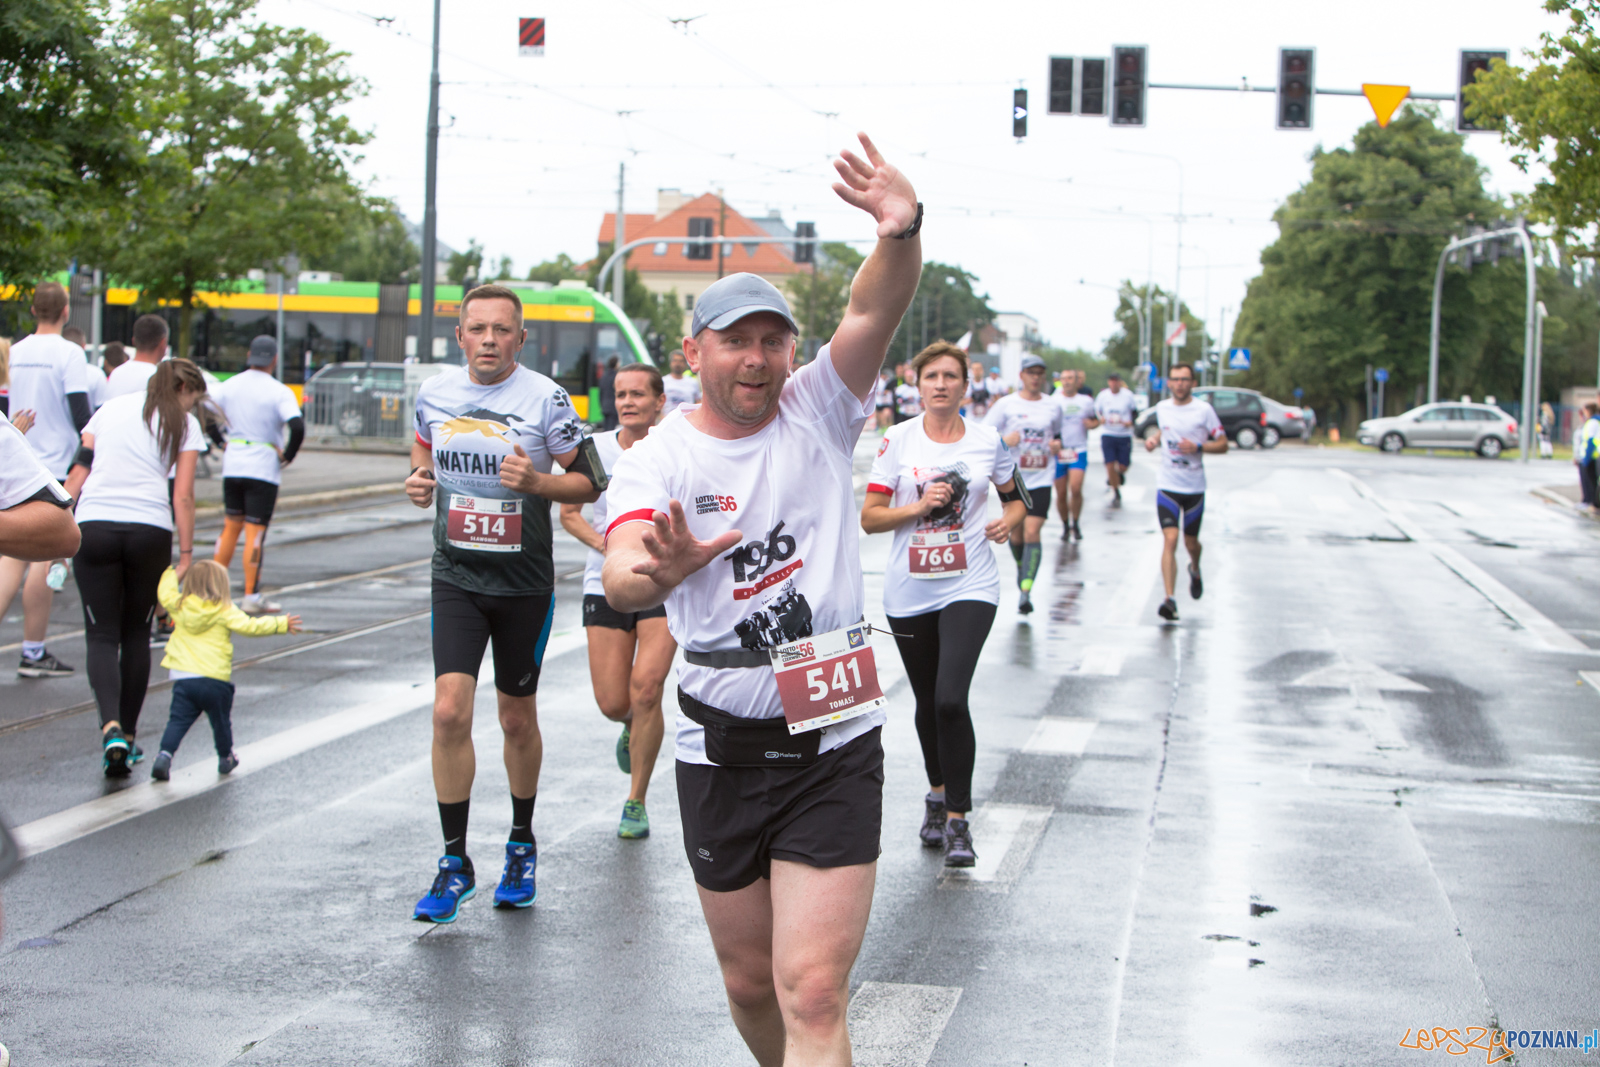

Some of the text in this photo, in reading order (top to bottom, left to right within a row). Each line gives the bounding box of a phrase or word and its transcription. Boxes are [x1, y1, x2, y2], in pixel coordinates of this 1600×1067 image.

[695, 494, 714, 504] LOTTO
[463, 513, 506, 536] 514
[917, 546, 955, 567] 766
[806, 656, 863, 702] 541
[828, 695, 855, 710] TOMASZ
